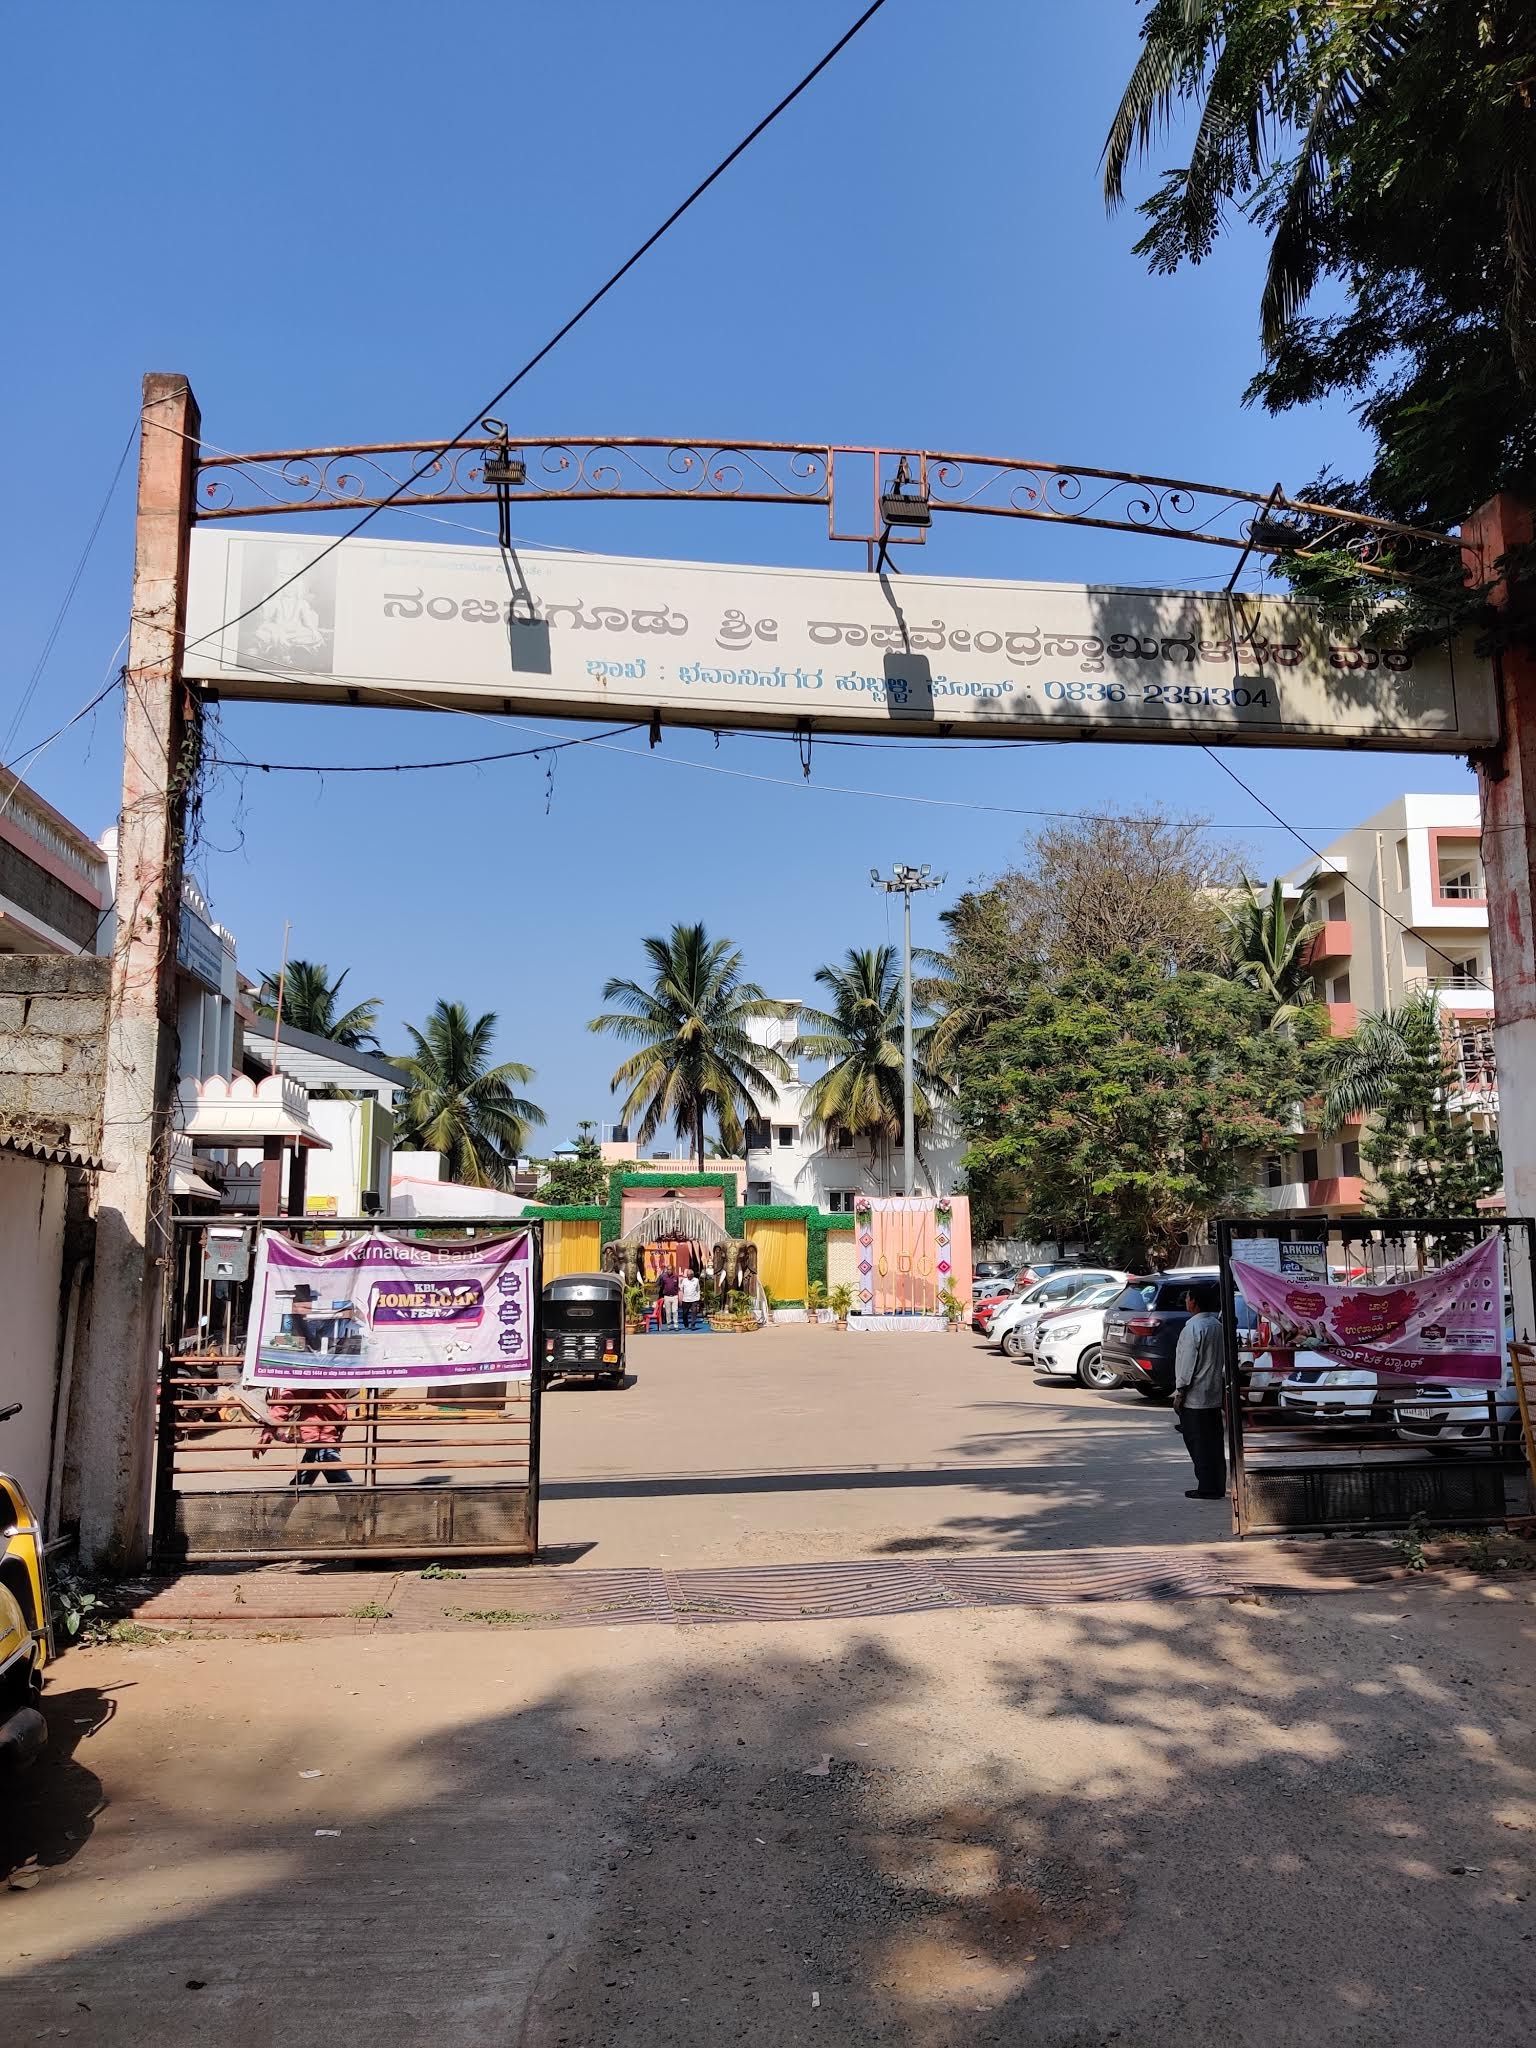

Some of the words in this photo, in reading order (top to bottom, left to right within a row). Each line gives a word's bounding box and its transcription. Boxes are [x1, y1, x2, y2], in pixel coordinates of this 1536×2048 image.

[715, 609, 778, 651] ಶ್ರೀ
[1329, 640, 1413, 671] ಮಠ
[679, 662, 824, 690] ಭವಾನಿನಗರ
[926, 676, 1014, 699] ಫೋನ್
[1044, 680, 1272, 708] 0836-2351304
[344, 1245, 431, 1261] Karnataka
[437, 1246, 485, 1261] Bank
[1282, 1244, 1320, 1255] ARKING
[414, 1283, 438, 1293] KBL
[410, 1308, 442, 1319] FEST
